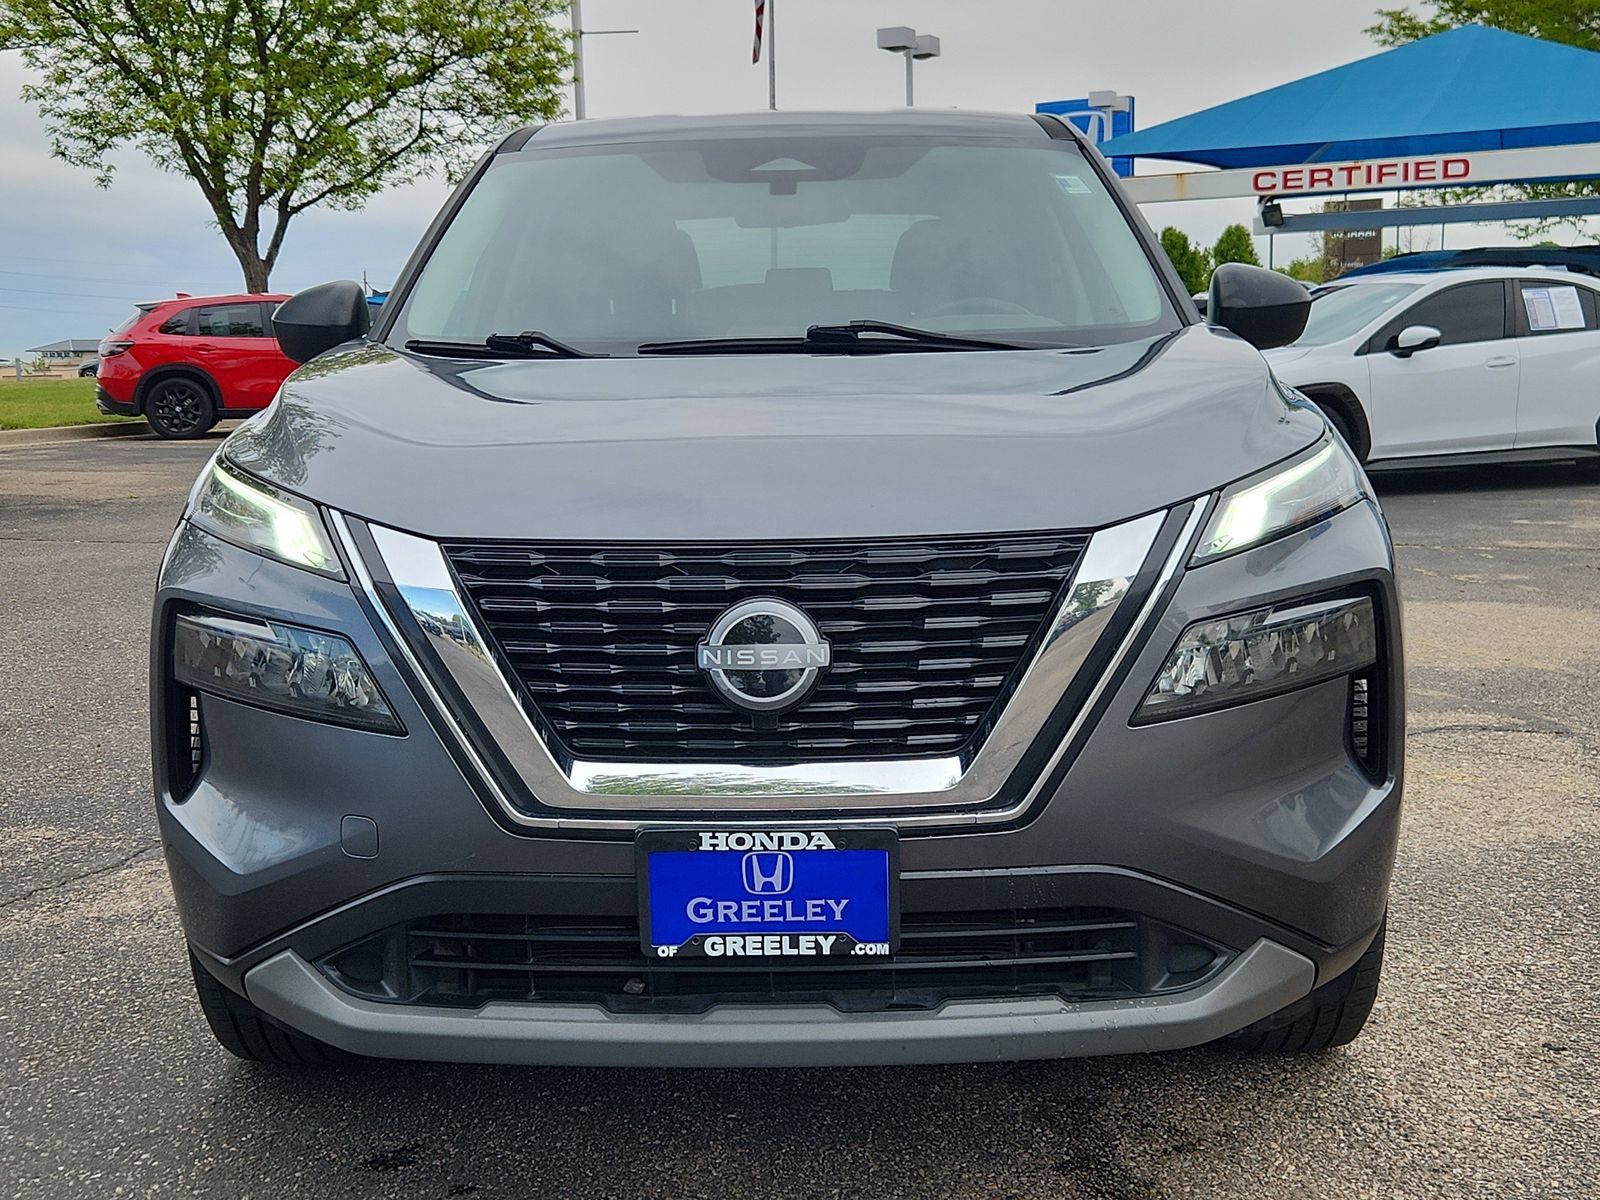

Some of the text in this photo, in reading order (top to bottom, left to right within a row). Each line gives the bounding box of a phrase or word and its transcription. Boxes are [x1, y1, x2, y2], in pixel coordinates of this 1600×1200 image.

[1252, 158, 1471, 192] CERTIFIED
[702, 648, 825, 666] NISSAN
[698, 831, 836, 851] HONDA
[686, 897, 850, 924] GREELEY
[657, 935, 890, 957] OF GREELEY .COM
